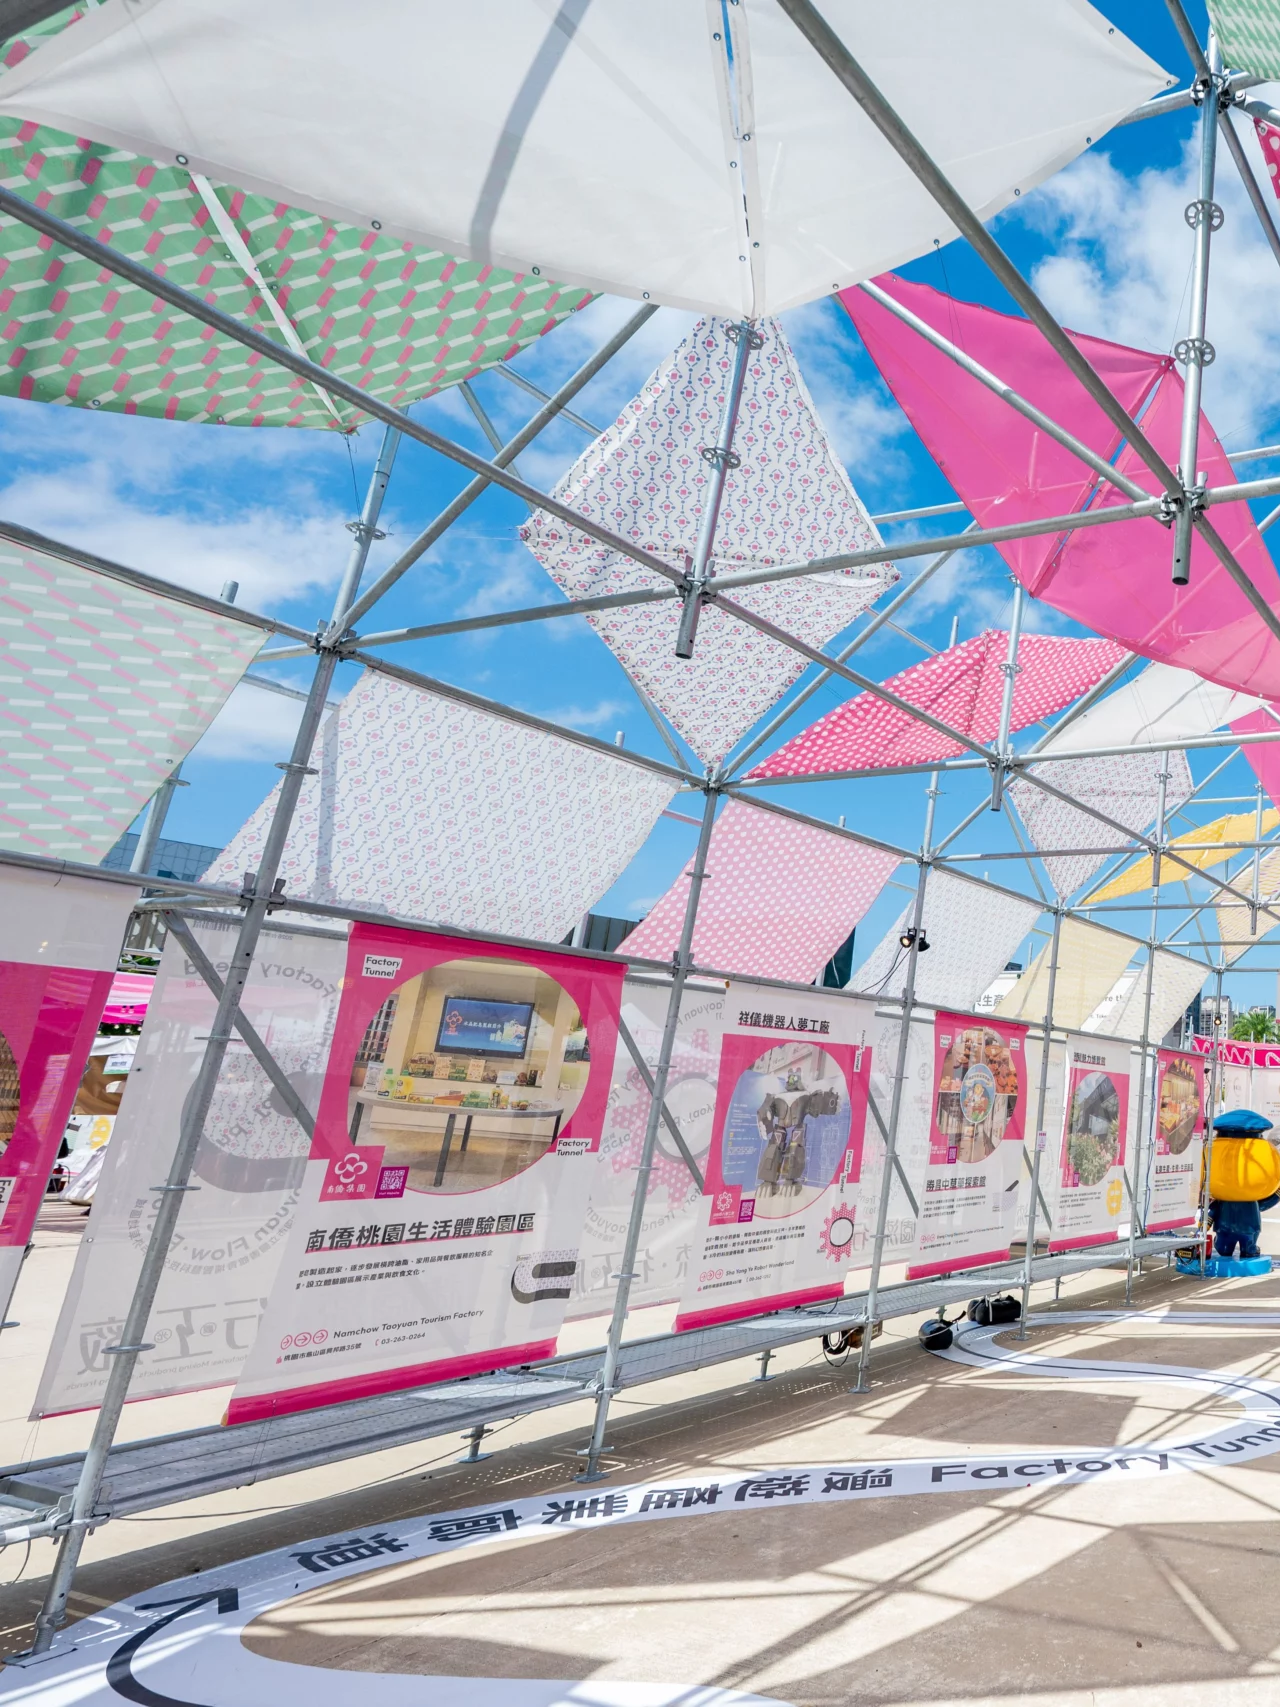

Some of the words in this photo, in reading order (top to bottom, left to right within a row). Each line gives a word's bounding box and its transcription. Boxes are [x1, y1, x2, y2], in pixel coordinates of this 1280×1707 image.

[365, 956, 400, 969] Factory
[364, 967, 395, 978] Tunnel
[738, 1011, 830, 1033] 祥儀機器人夢工廠
[558, 1139, 590, 1148] Factory
[557, 1148, 583, 1157] Tunnel
[326, 1183, 366, 1194] 南僑集團
[306, 1213, 536, 1252] 南僑桃園生活體驗園區
[333, 1324, 379, 1339] Namchow
[381, 1318, 418, 1332] Taoyuan
[420, 1313, 452, 1325] Tourism
[453, 1309, 484, 1320] Factory
[381, 1331, 426, 1346] 03-263-0264
[930, 1453, 1170, 1483] Factory
[295, 1467, 894, 1573] 漫遊產業廊道
